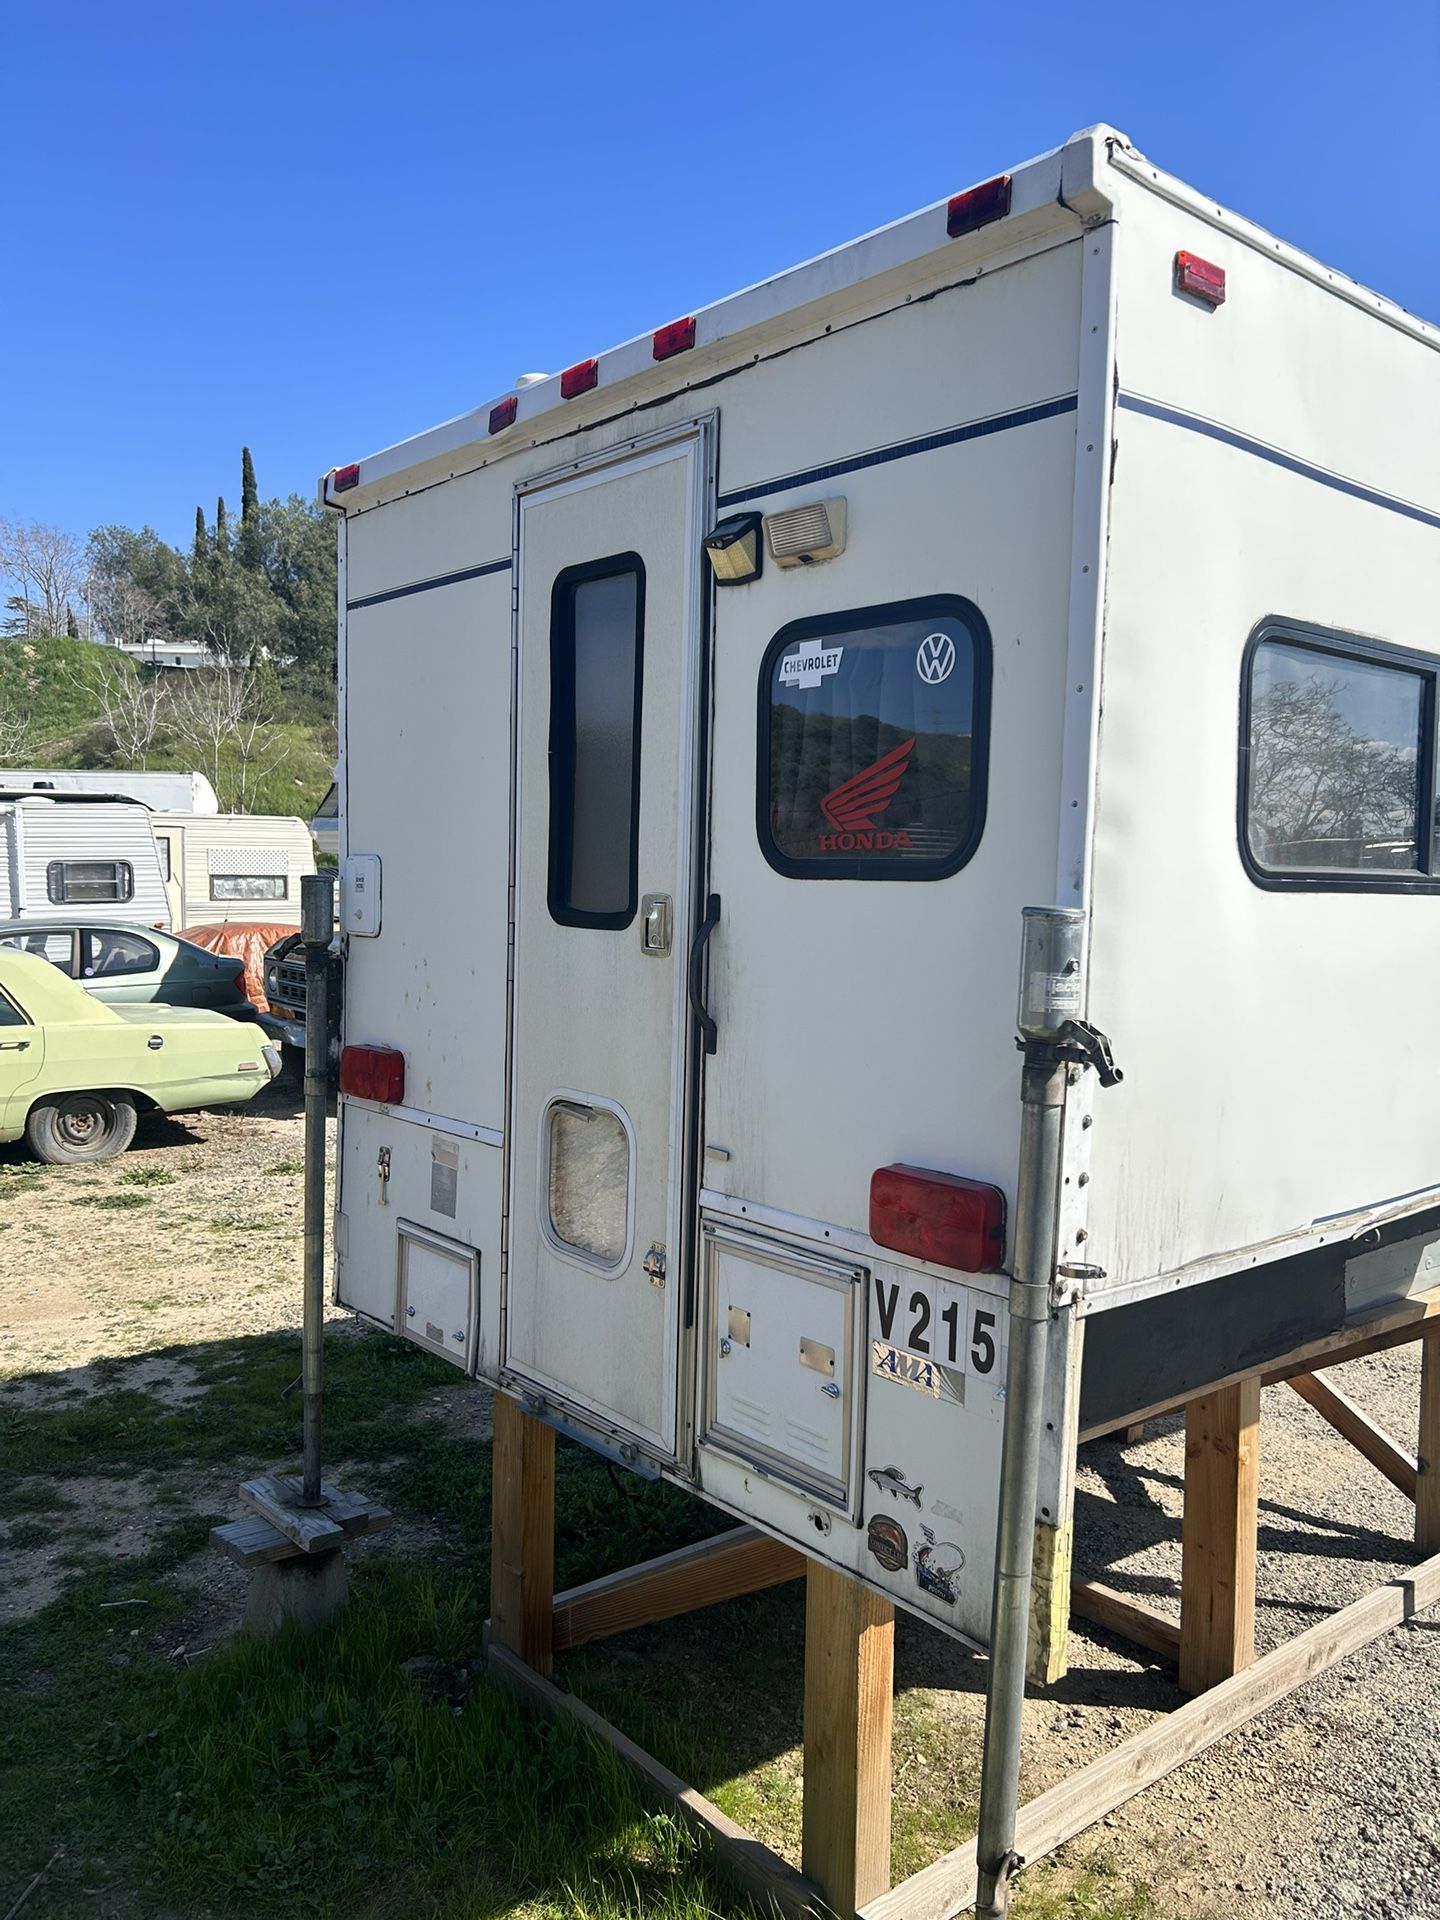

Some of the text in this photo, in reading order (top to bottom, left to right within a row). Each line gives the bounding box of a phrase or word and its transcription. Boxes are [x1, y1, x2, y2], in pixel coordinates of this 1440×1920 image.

[783, 653, 839, 675] CHEVROLET
[917, 633, 955, 683] VW
[818, 831, 913, 850] HONDA
[875, 1278, 996, 1374] V215
[877, 1350, 933, 1388] AMA
